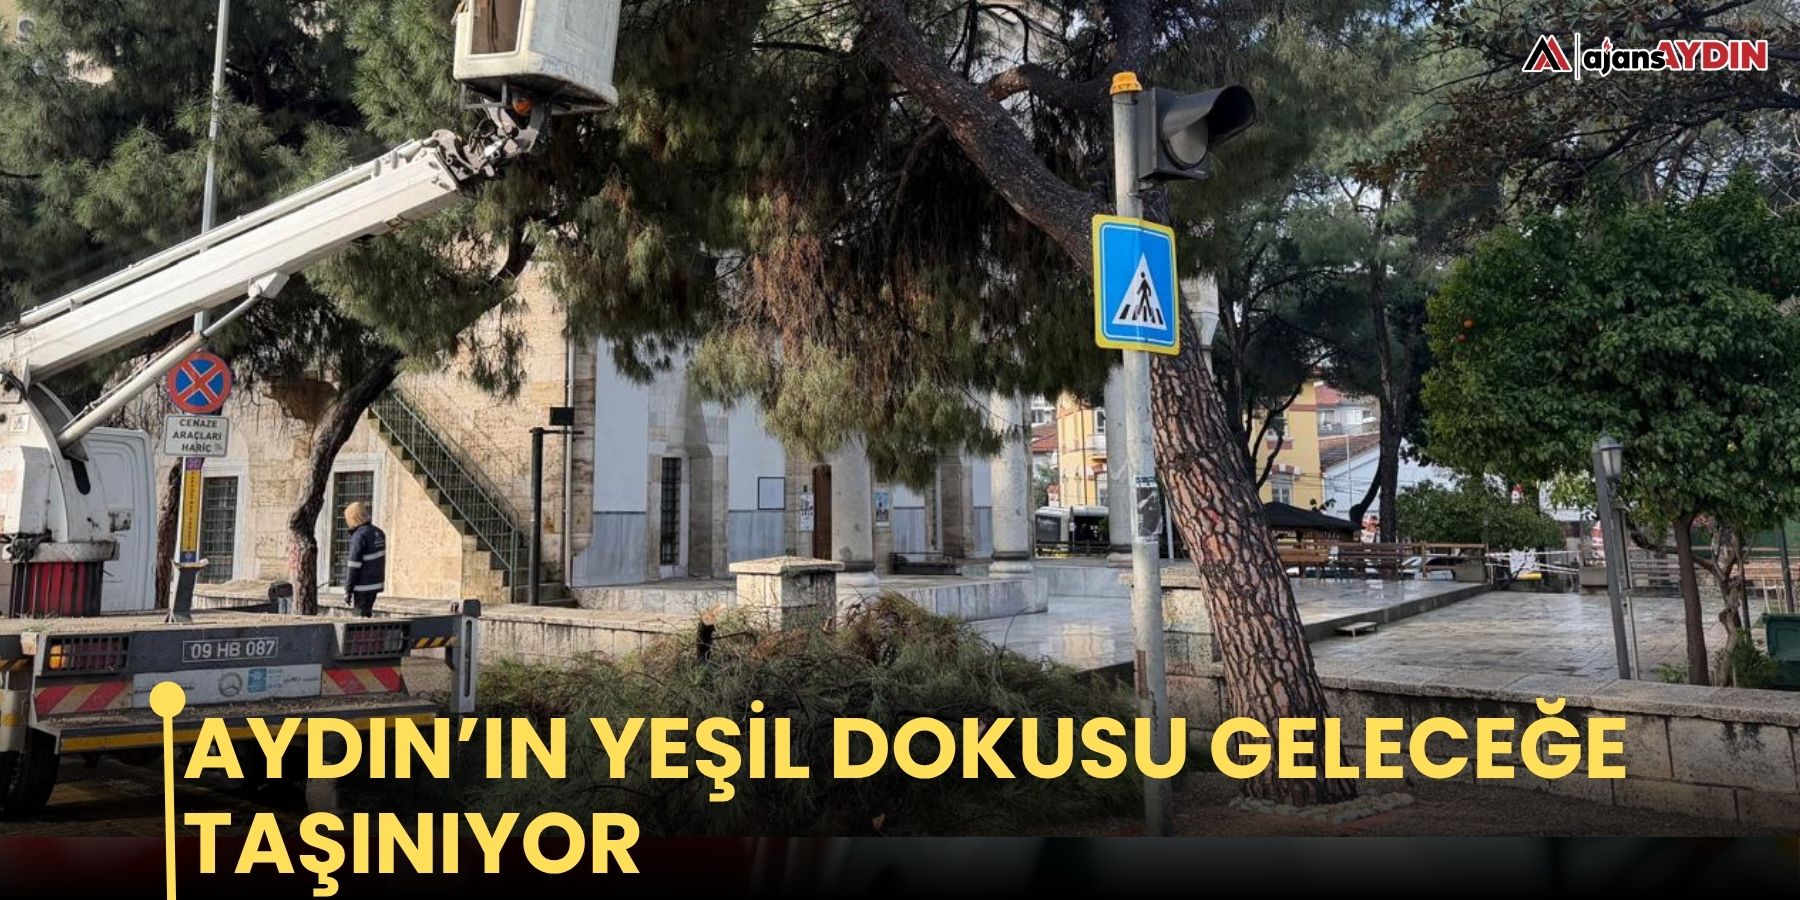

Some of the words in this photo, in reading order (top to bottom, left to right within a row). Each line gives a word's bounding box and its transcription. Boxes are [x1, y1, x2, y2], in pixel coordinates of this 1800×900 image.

[179, 418, 218, 428] CENAZE
[172, 431, 222, 441] ARAÇLARI
[181, 442, 212, 453] HARİÇ
[191, 643, 212, 659] 09
[217, 642, 241, 657] HB
[246, 640, 275, 656] 087
